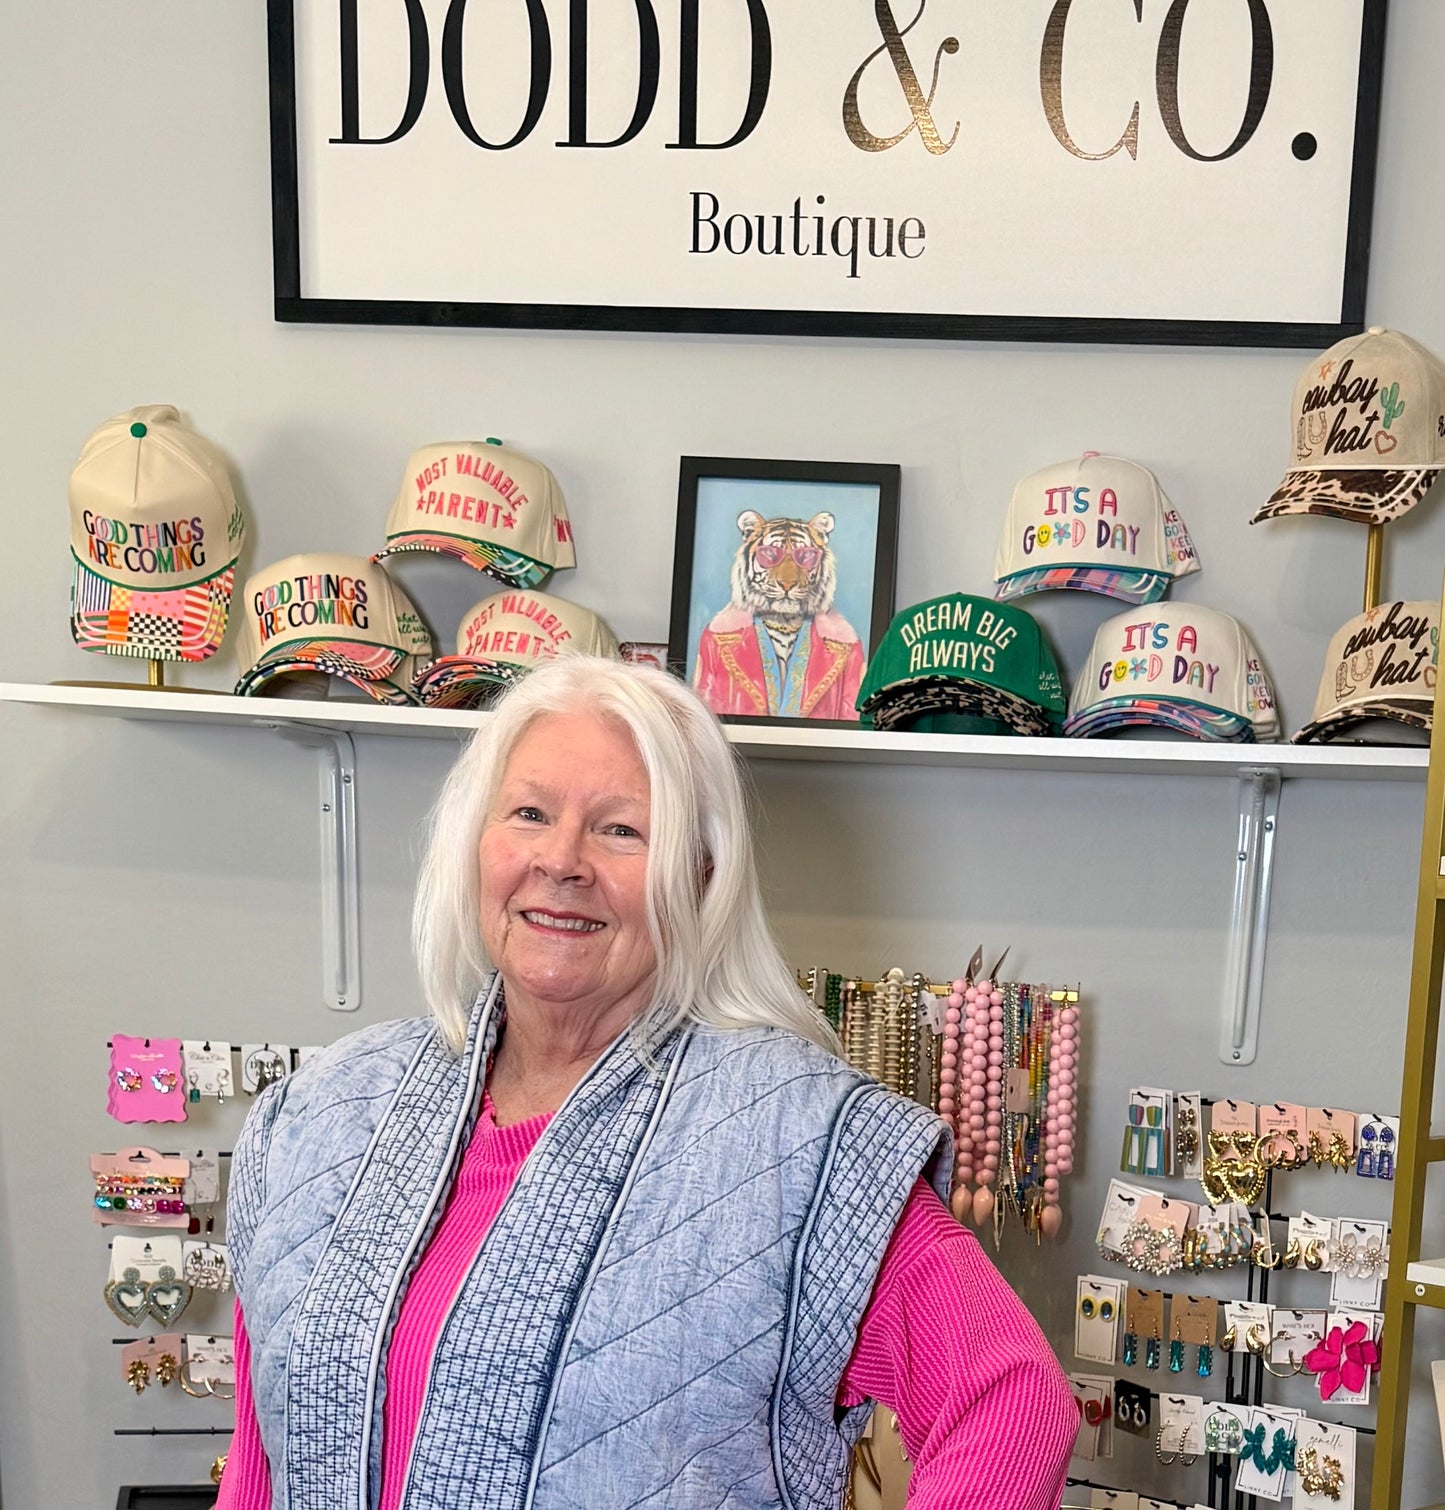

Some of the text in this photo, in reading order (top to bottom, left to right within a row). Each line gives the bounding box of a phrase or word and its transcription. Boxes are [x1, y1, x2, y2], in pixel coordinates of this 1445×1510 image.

[327, 0, 1319, 163] DODD & CO.
[688, 191, 926, 279] Boutique
[1323, 405, 1380, 457] hat
[415, 453, 529, 512] MOST VALUABLE
[1044, 485, 1118, 517] IT'S A
[83, 510, 128, 545] GOOD
[130, 517, 205, 549] THINGS
[425, 491, 504, 529] PARENT
[88, 535, 206, 574] ARE COMING
[1095, 519, 1141, 556] DAY
[254, 573, 369, 617] GOOD THINGS
[259, 601, 369, 646] ARE COMING
[466, 595, 572, 647] MOST VALUABLE
[900, 602, 1018, 651] DREAM BIG
[1121, 621, 1197, 655] IT'S A
[472, 631, 548, 657] PARENT
[909, 638, 997, 674] ALWAYS
[1172, 655, 1220, 694] DAY
[1369, 643, 1432, 690] hat
